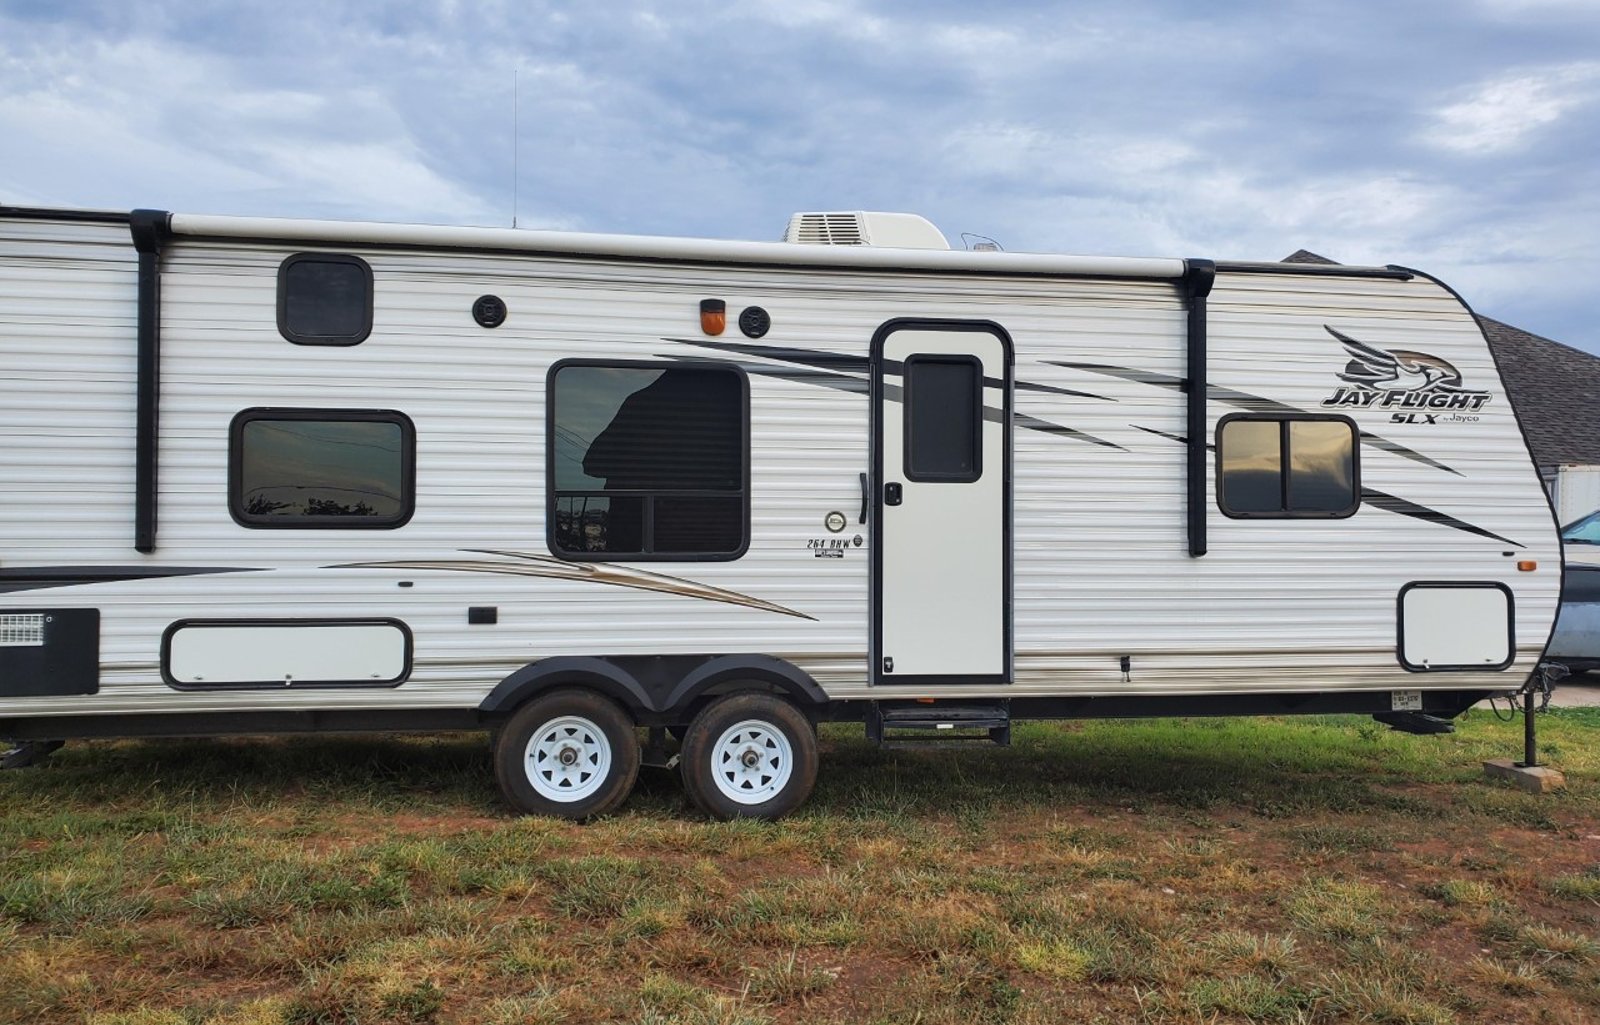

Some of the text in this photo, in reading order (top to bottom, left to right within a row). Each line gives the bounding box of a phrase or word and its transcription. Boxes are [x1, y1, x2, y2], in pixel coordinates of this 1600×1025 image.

[1322, 388, 1490, 409] JAY FLIGHT
[1389, 413, 1441, 424] SLX
[1449, 413, 1480, 423] Jayco
